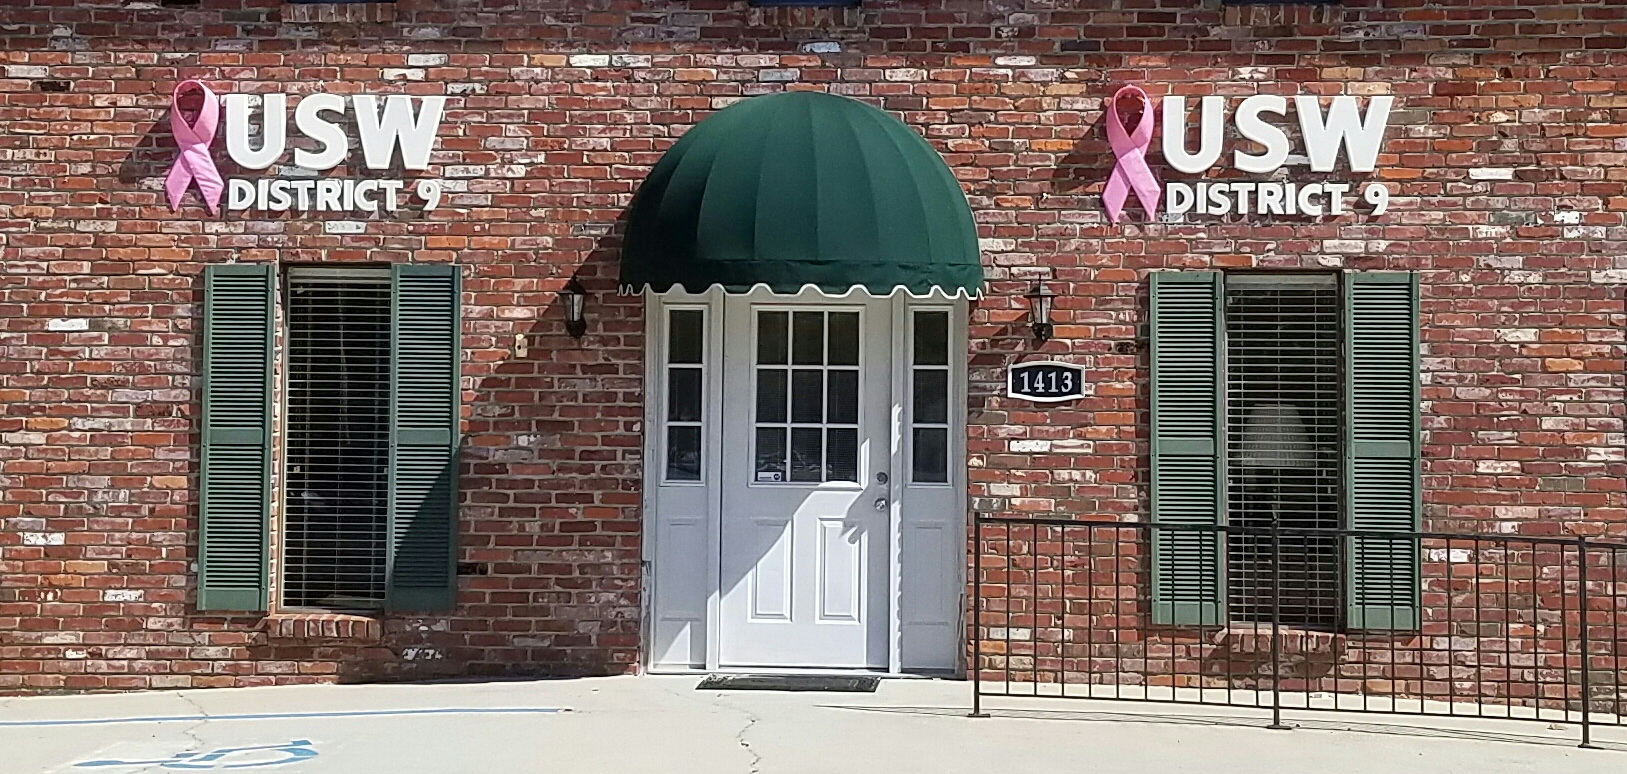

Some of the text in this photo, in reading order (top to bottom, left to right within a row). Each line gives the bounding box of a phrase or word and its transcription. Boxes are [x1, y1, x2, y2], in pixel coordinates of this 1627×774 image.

[225, 93, 446, 170] USW
[1162, 94, 1395, 173] USW
[228, 178, 442, 212] DISTRICT 9
[1166, 182, 1389, 216] DISTRICT 9
[1020, 370, 1073, 393] 1413
